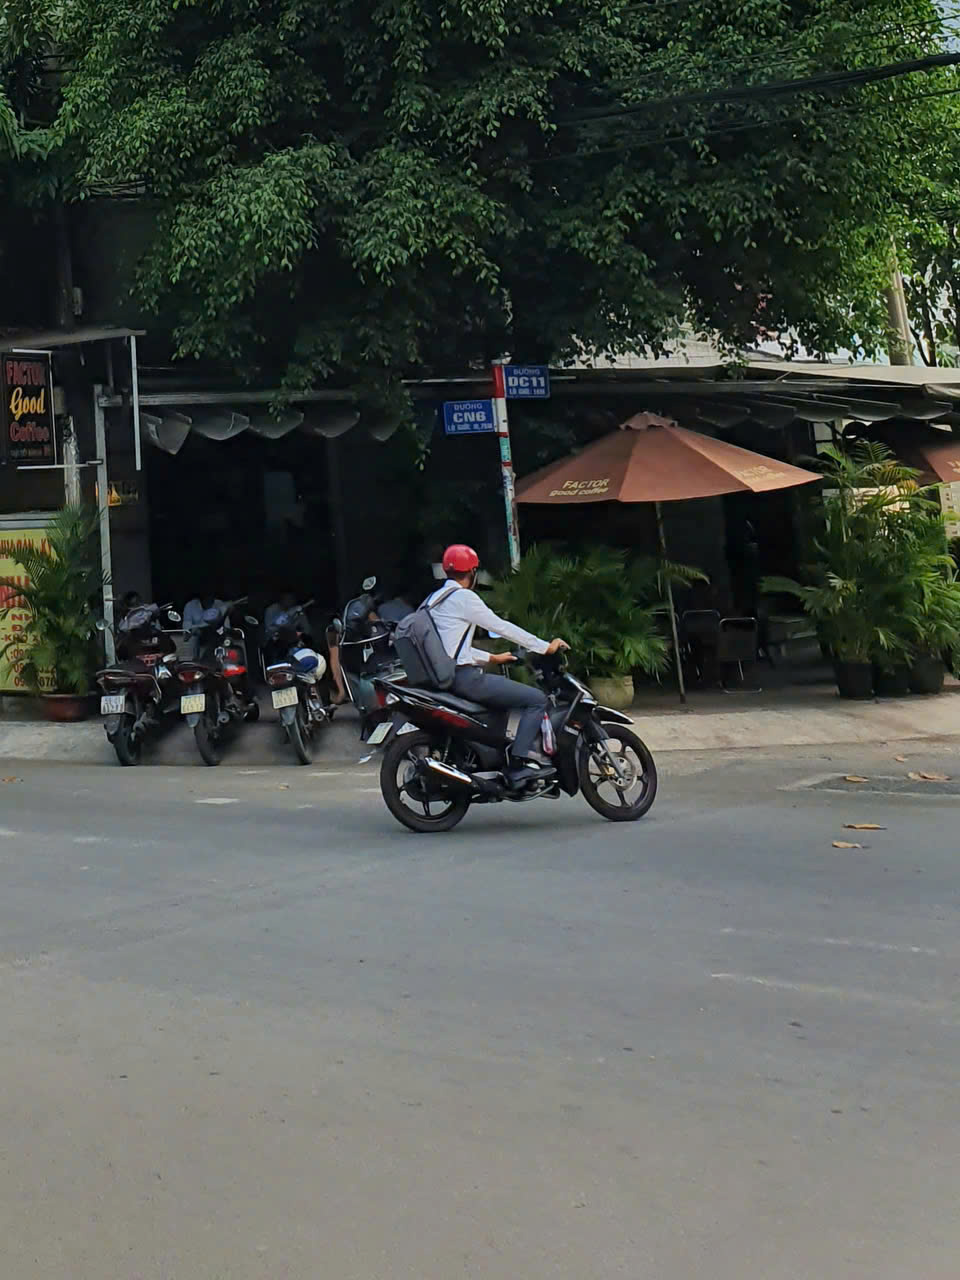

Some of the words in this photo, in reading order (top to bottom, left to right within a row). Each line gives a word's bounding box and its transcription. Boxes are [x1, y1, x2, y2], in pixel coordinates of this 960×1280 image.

[508, 376, 545, 387] DC11
[10, 387, 46, 421] Good
[562, 479, 609, 489] FACTOR
